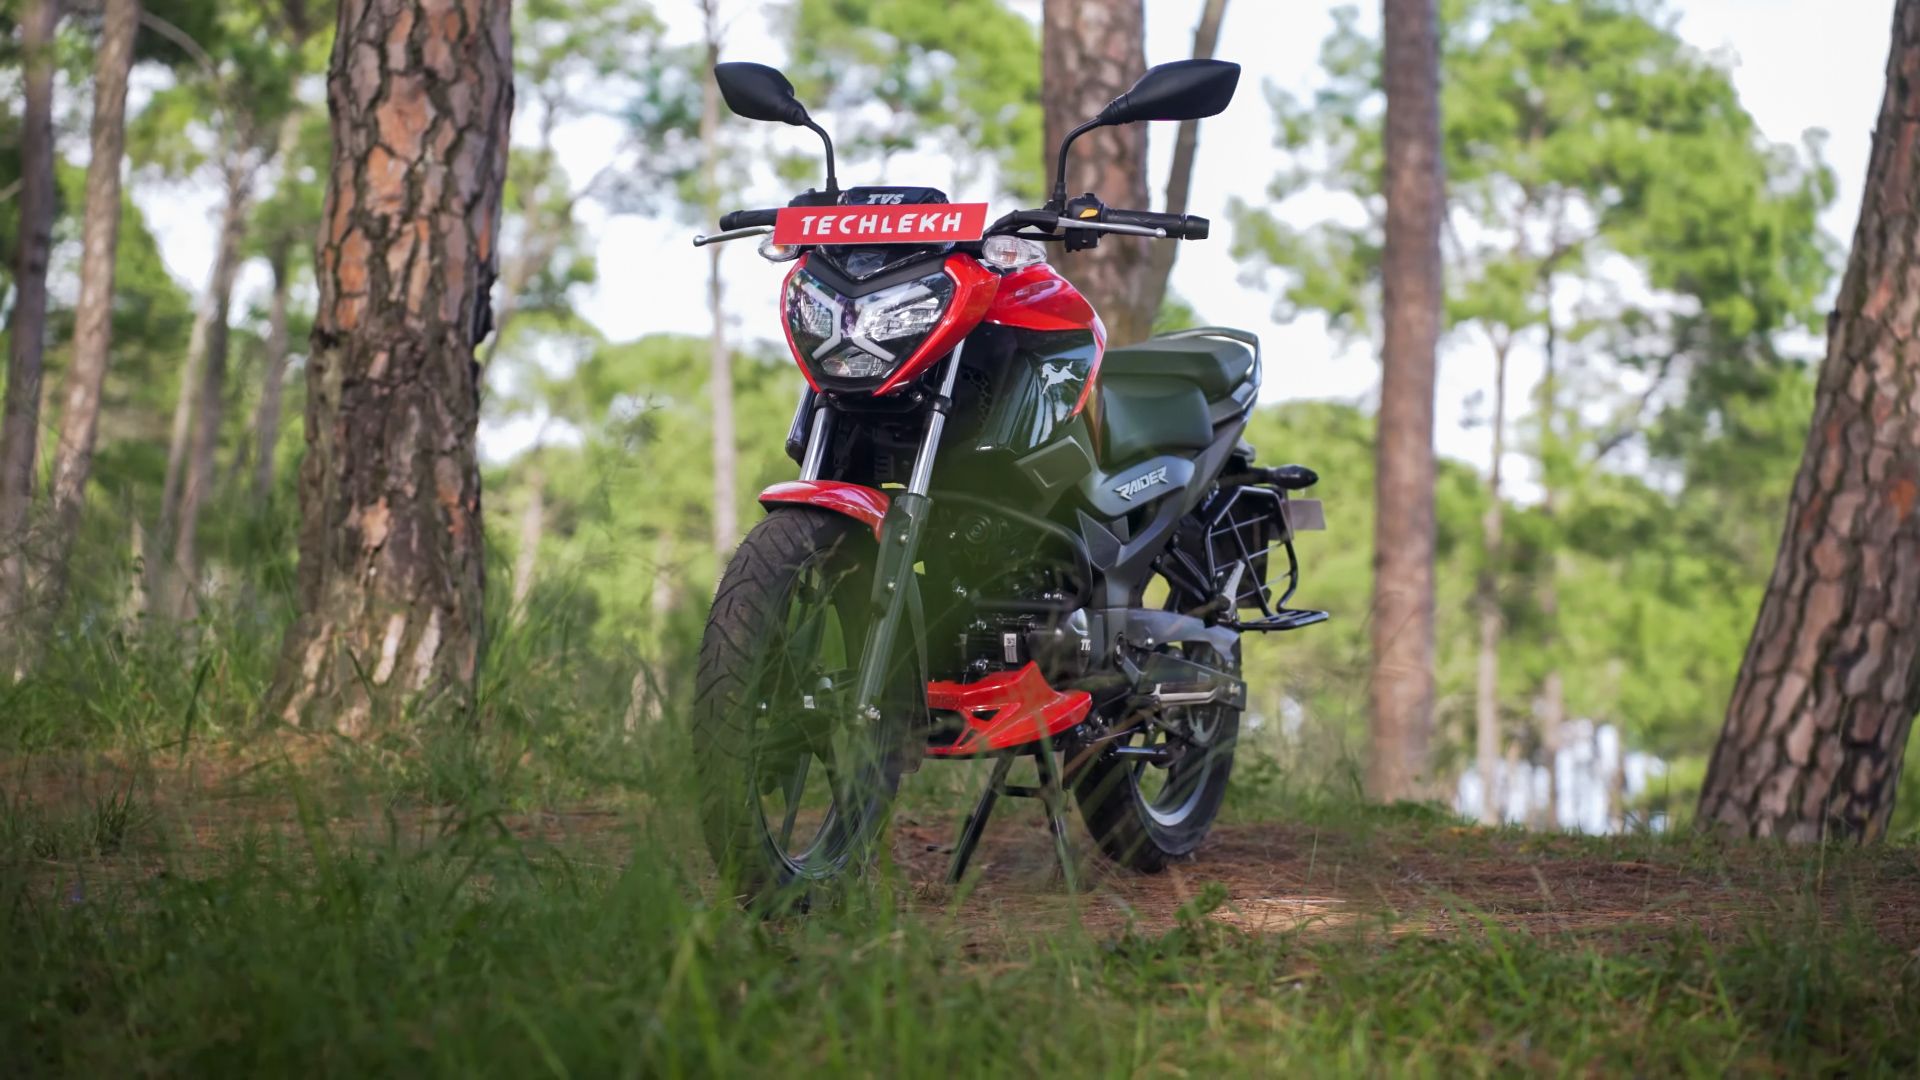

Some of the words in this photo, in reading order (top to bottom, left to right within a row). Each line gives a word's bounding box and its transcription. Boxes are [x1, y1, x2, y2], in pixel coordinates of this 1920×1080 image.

[866, 193, 905, 205] TVS
[801, 212, 962, 236] TECHLEKH
[1113, 465, 1169, 500] RAIDER
